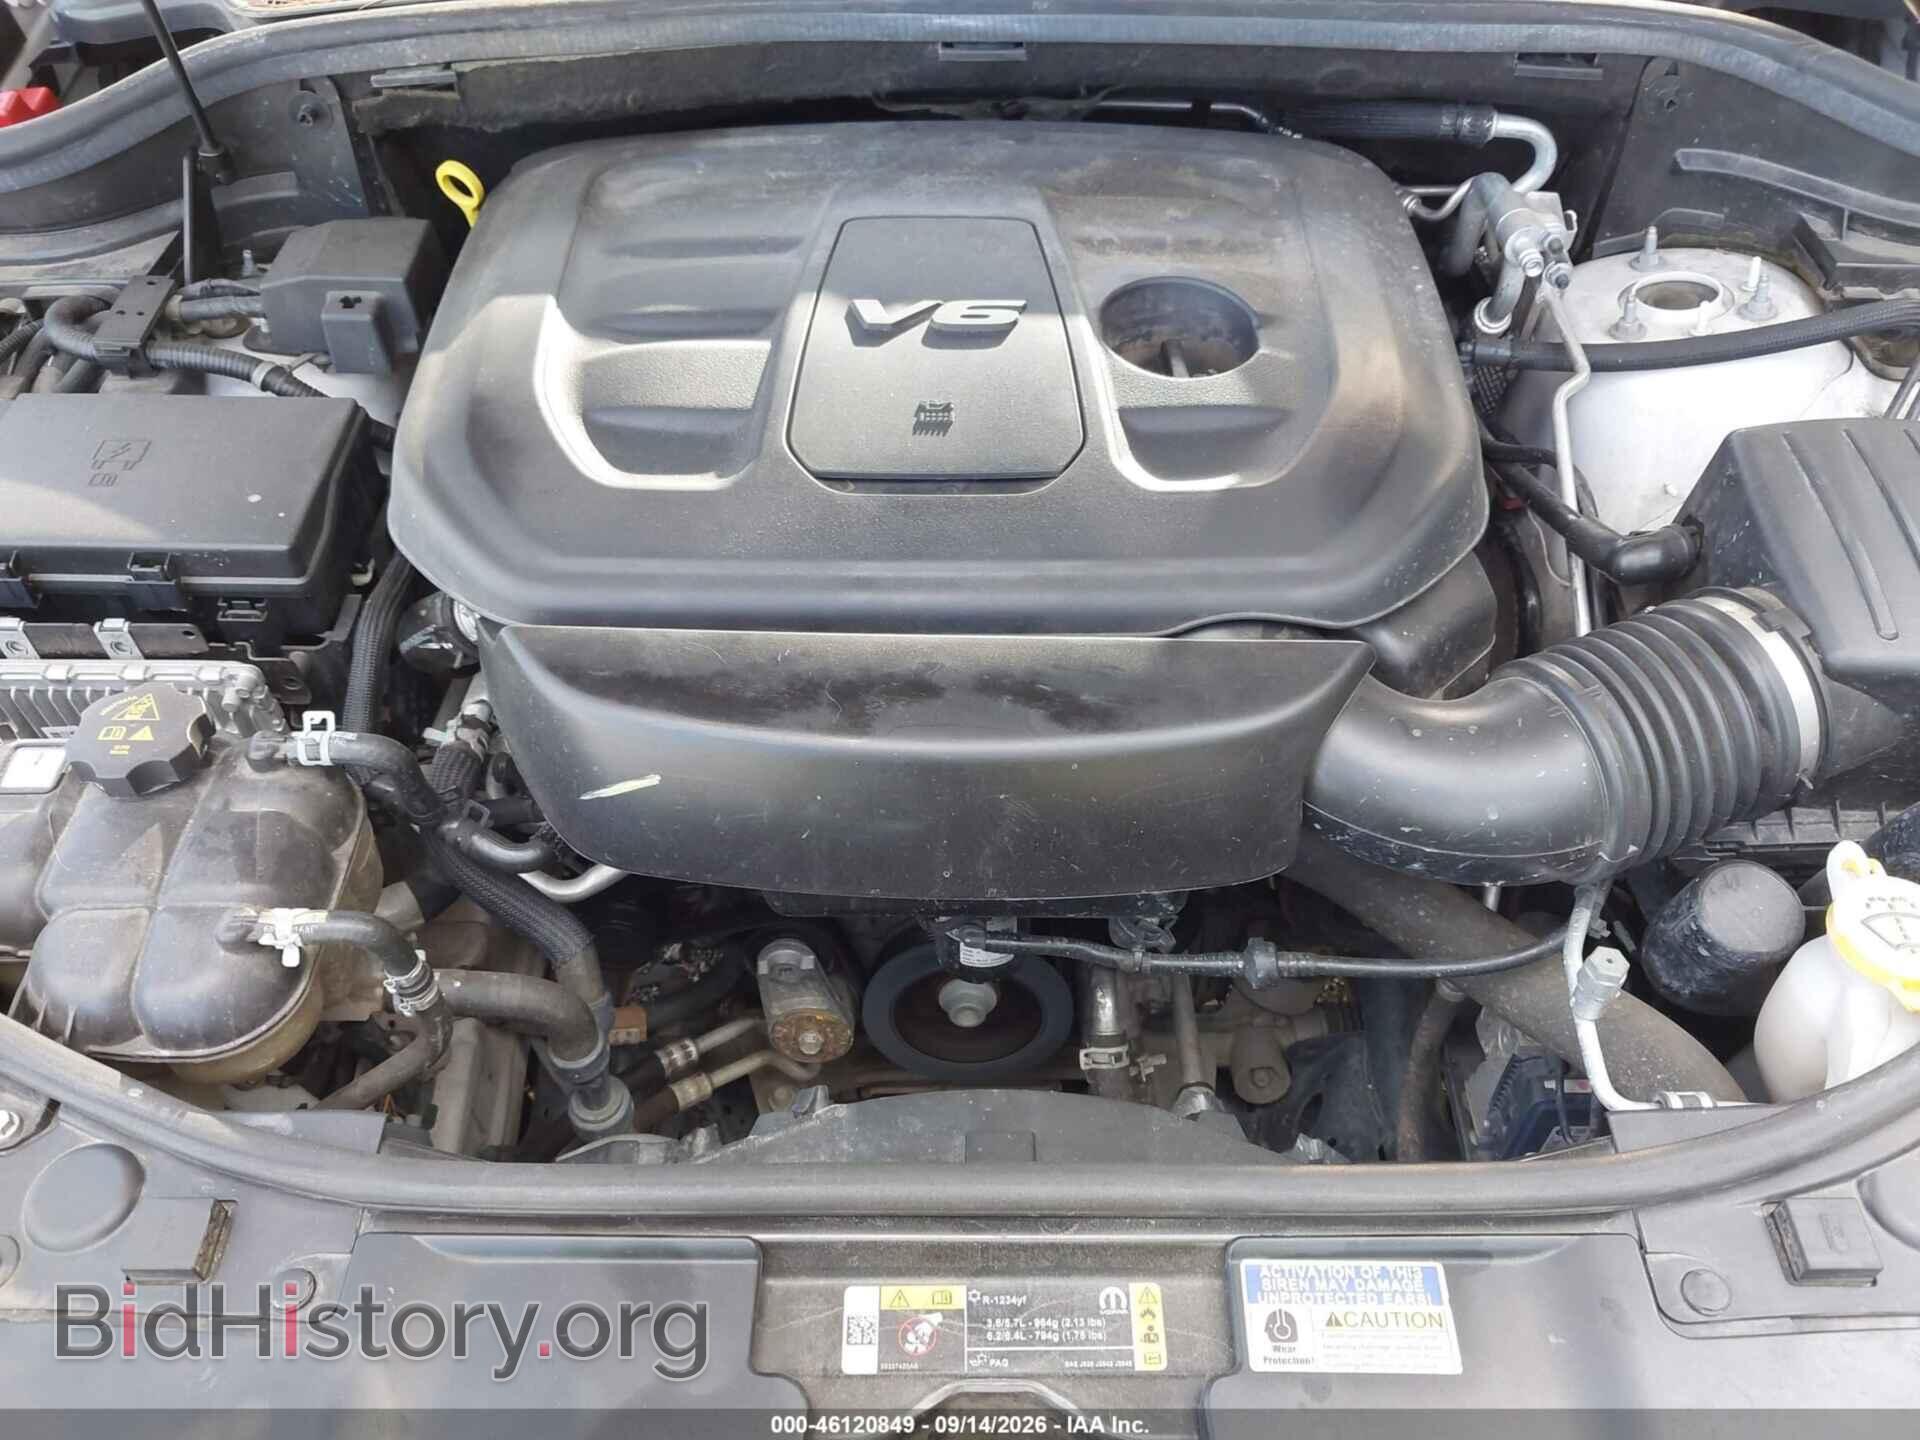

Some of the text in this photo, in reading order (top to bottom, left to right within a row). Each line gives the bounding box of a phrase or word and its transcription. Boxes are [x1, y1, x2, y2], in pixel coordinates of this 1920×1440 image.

[846, 299, 1027, 347] V6
[1259, 1264, 1424, 1280] ACTIVATION OF THIS
[1314, 1279, 1350, 1292] MAY
[1353, 1279, 1425, 1293] DAMAGE
[982, 1295, 1027, 1307] R-1234yf
[1257, 1291, 1378, 1305] UNPROTECTED
[1343, 1311, 1443, 1329] CAUTION
